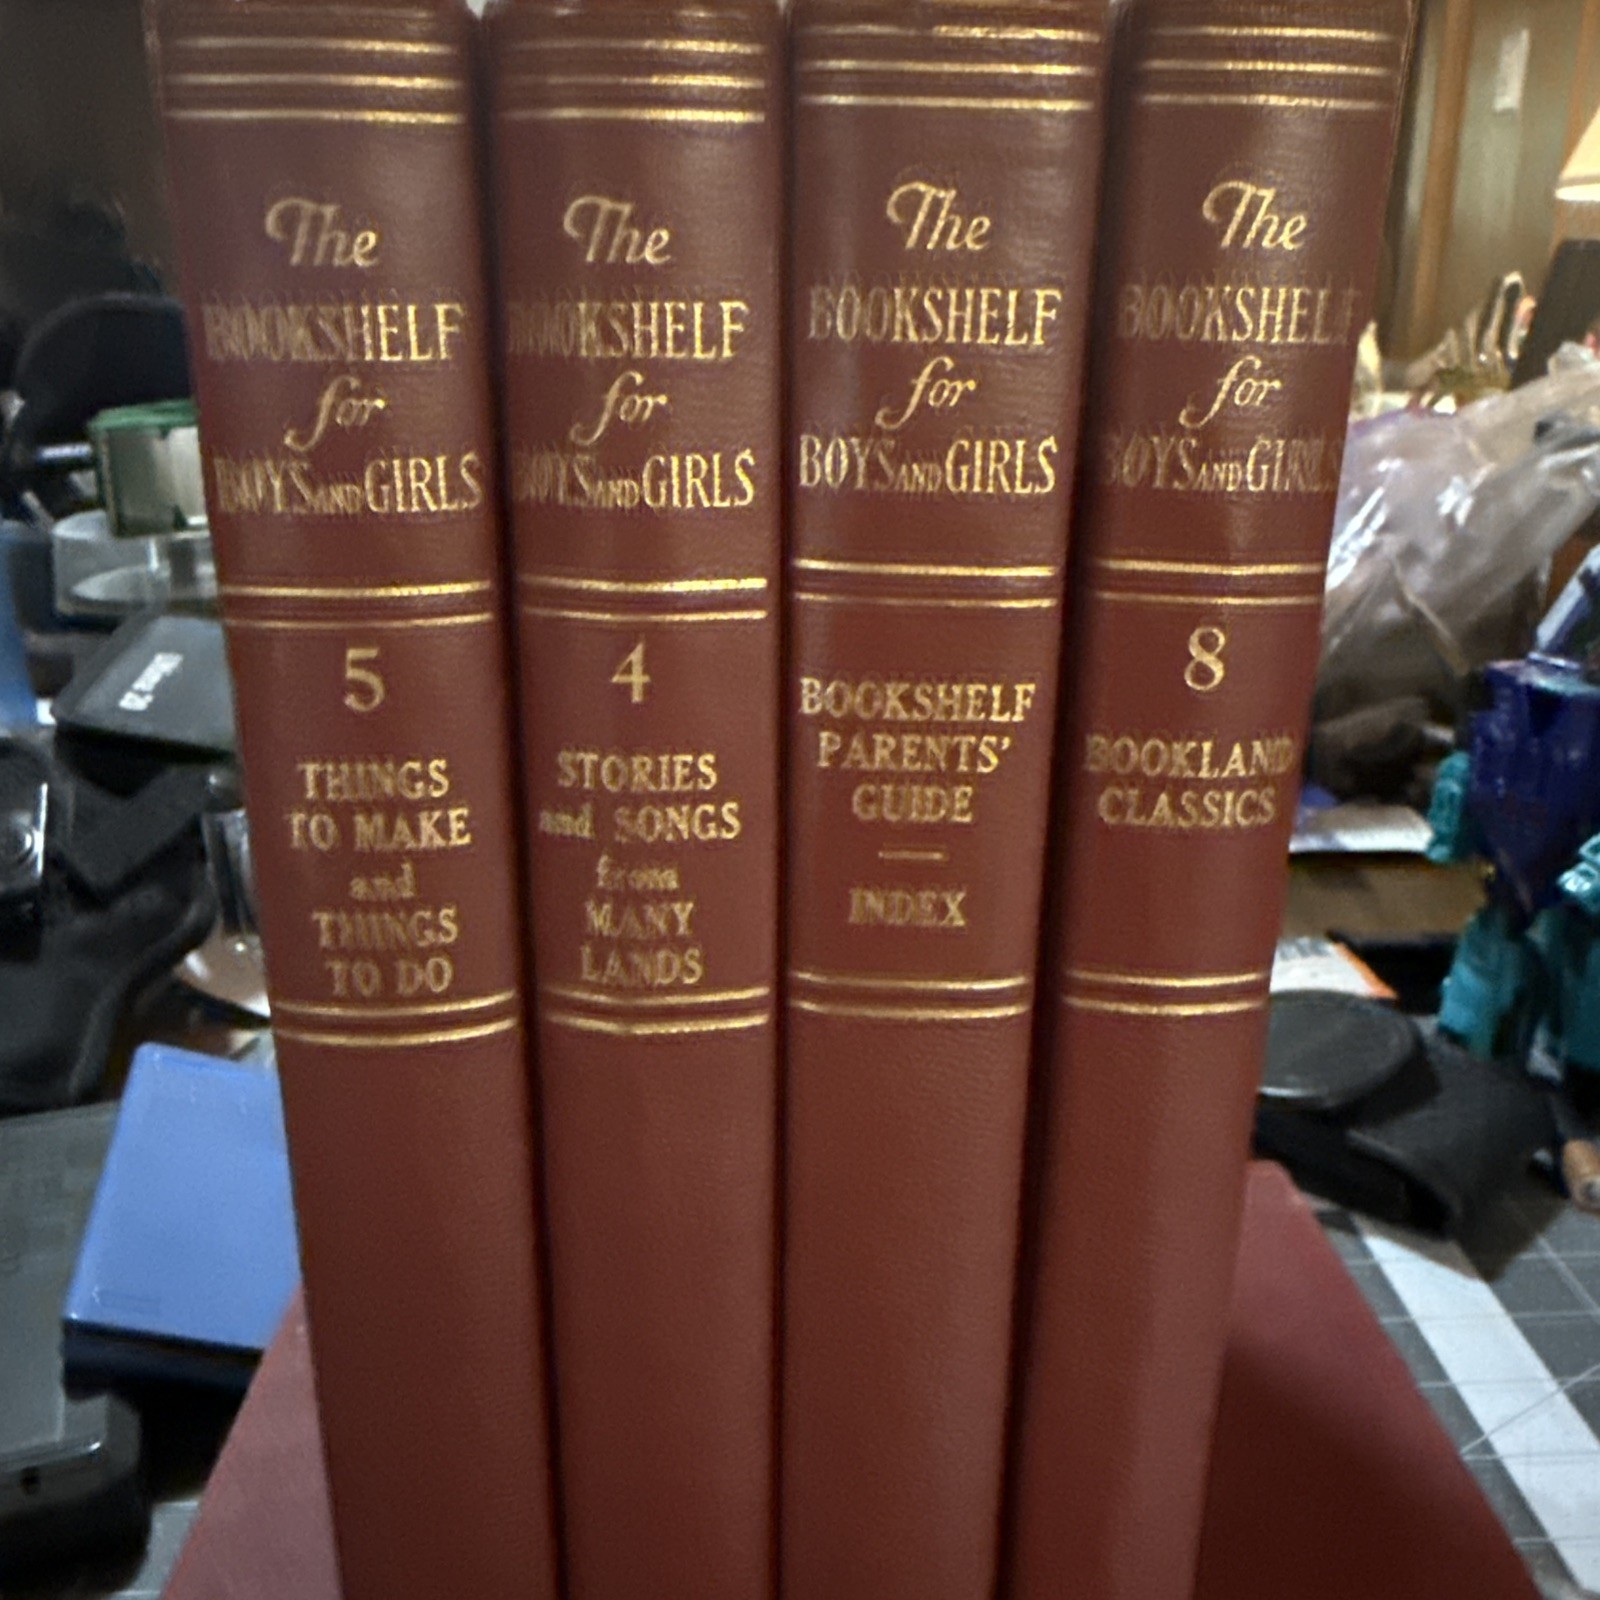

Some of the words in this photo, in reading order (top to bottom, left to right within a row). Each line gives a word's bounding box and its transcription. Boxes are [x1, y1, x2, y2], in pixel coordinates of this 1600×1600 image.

[265, 198, 378, 268] The
[563, 196, 672, 264] The
[887, 180, 991, 251] The
[1203, 180, 1308, 250] The
[808, 286, 1062, 345] BOOKSHELF
[284, 376, 386, 451] for
[569, 370, 668, 446] for
[874, 356, 976, 429] for
[1178, 355, 1282, 428] for
[364, 452, 486, 513] GIRLS
[642, 448, 755, 508] GIRLS
[800, 434, 896, 490] BOYS
[896, 462, 943, 492] AND
[945, 436, 1058, 494] GIRLS
[1196, 461, 1243, 492] AND
[343, 648, 386, 712] 5
[611, 642, 651, 703] 4
[1184, 626, 1226, 691] 8
[800, 676, 1036, 722] BOOKSHELF
[300, 759, 450, 800] THINGS
[558, 753, 718, 792] STORIES
[1084, 735, 1294, 779] BOOKLAND
[289, 813, 337, 850] TO
[355, 808, 472, 850] MAKE
[539, 811, 594, 840] and
[614, 803, 741, 843] SONGS
[852, 785, 974, 823] GUIDE
[1099, 788, 1277, 827] CLASSICS
[350, 864, 416, 899] and
[849, 888, 966, 926] INDEX
[314, 905, 459, 949] THINGS
[585, 902, 694, 938] MANY
[328, 960, 380, 996] TO
[396, 957, 454, 993] DO
[580, 946, 704, 985] LANDS
